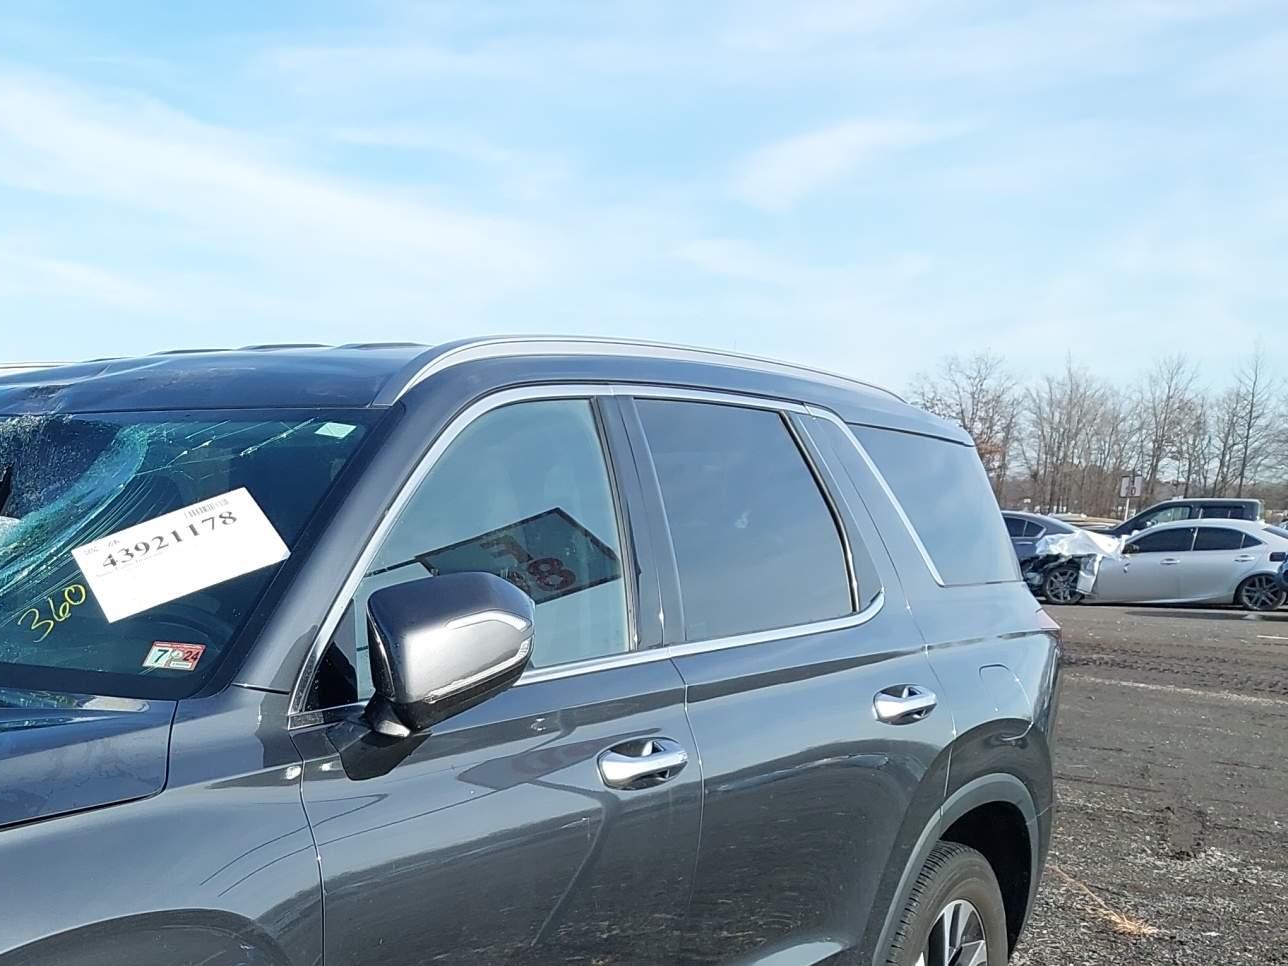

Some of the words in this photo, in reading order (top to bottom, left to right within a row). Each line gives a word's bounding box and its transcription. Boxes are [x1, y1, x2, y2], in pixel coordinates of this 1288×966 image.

[102, 511, 238, 568] 43921178
[17, 584, 86, 643] 360
[156, 649, 169, 663] 7
[183, 650, 200, 662] 24
